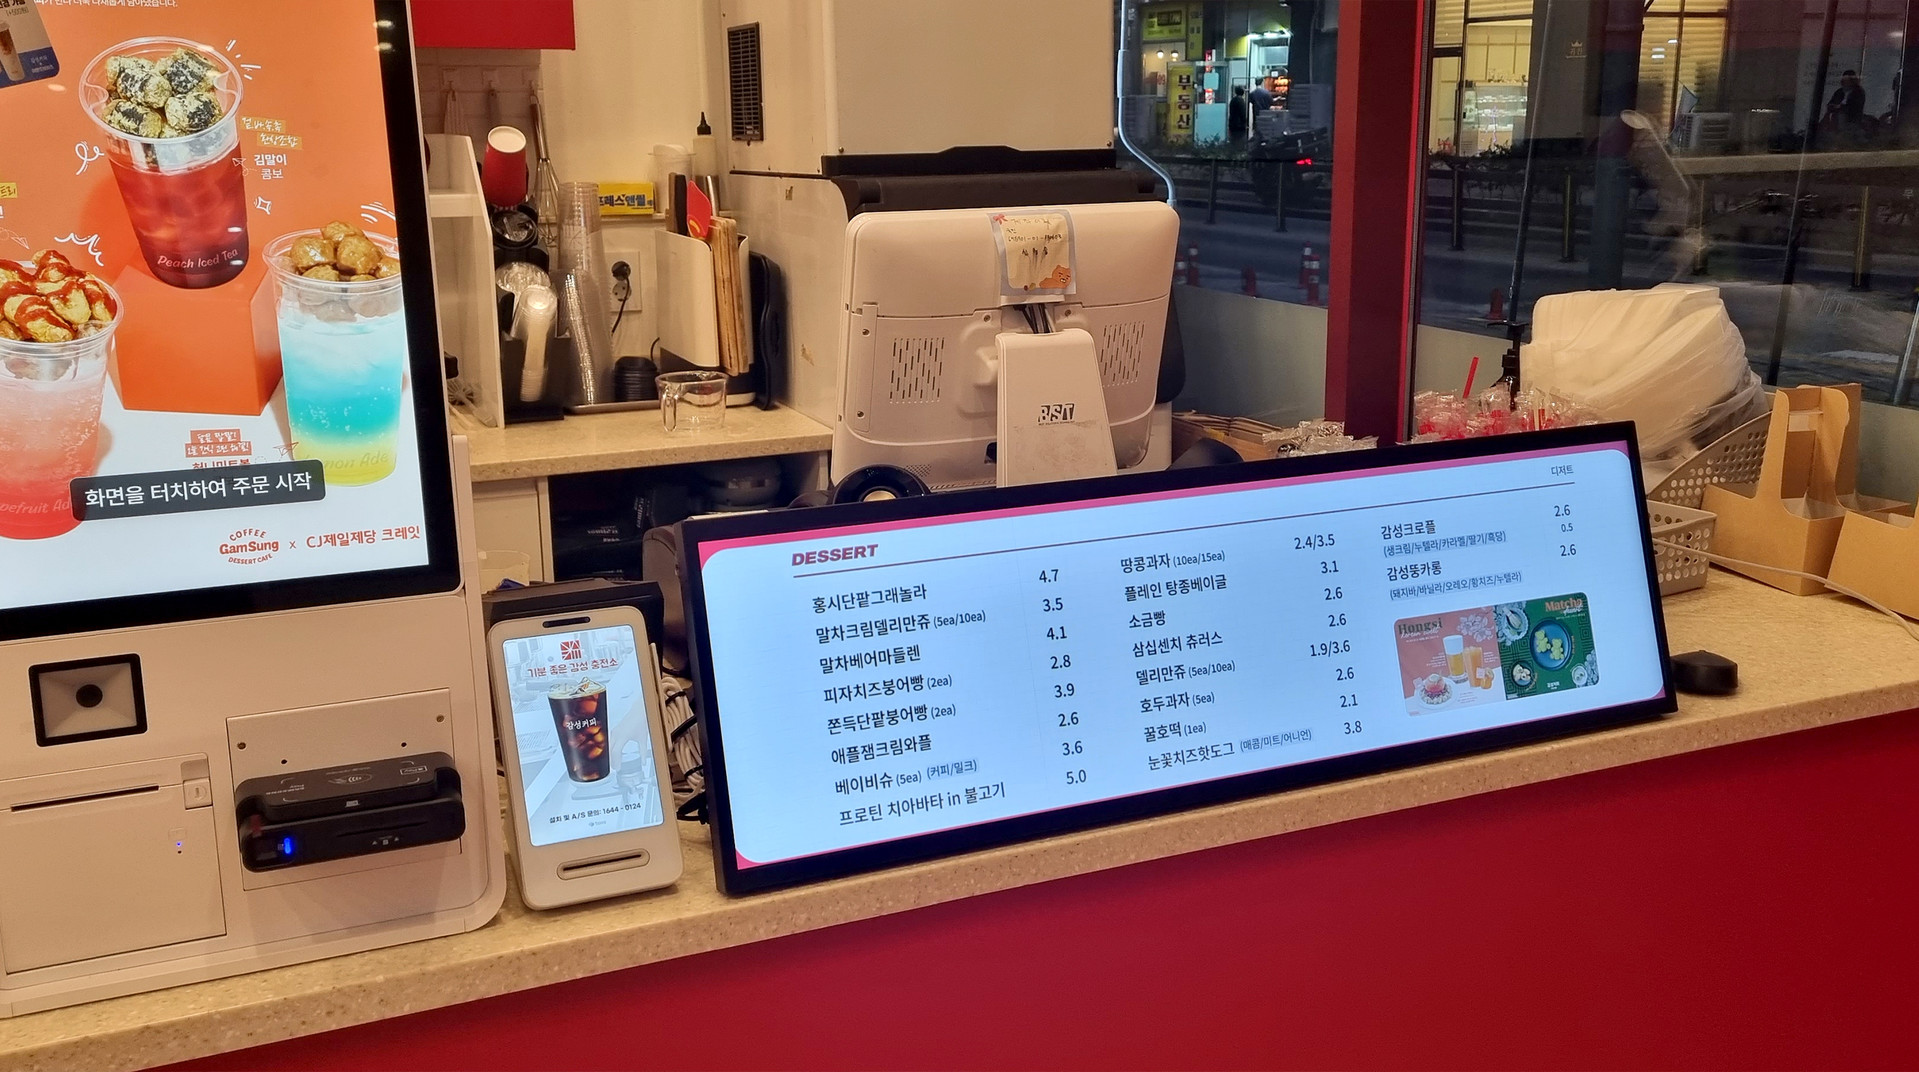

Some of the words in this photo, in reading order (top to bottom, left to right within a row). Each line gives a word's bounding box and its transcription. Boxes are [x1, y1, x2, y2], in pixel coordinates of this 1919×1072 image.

[1177, 74, 1191, 130] 부동산
[254, 154, 287, 166] 김말이
[261, 168, 284, 180] 콤보
[157, 255, 194, 268] Peach
[197, 254, 220, 268] Iced
[221, 248, 239, 261] Tea
[1037, 402, 1075, 423] BST
[1551, 464, 1574, 477] 디저트
[85, 485, 145, 508] 화면을
[150, 478, 227, 503] 터치하여
[232, 474, 271, 496] 주문
[275, 471, 313, 492] 시작
[1554, 504, 1571, 518] 2.6
[229, 528, 267, 542] COFFEE
[1381, 519, 1436, 540] 감성크로플
[1561, 522, 1574, 533] 0.5
[219, 540, 280, 555] GamSung
[306, 529, 377, 548] CJ제일제당
[381, 525, 420, 541] 크레잇
[1294, 533, 1335, 551] 2.4/3.5
[228, 556, 257, 565] DESSERT
[257, 553, 273, 564] CAFE
[791, 543, 879, 567] DESSERT
[1560, 543, 1577, 557] 2.6
[1120, 553, 1171, 574] 땅콩과자
[1172, 550, 1225, 568] (10ea/15ea)
[1320, 560, 1339, 574] 3.1
[1387, 560, 1442, 582] 감성뚱카롱
[1039, 569, 1059, 583] 4.7
[1124, 582, 1162, 602] 플레인
[1166, 573, 1227, 596] 탕종베이글
[1324, 586, 1343, 601] 2.6
[812, 583, 928, 614] 홍시단팥그래놀라
[1042, 597, 1063, 612] 3.5
[1545, 597, 1583, 611] Matcha
[816, 613, 930, 644] 말차크림델리만쥬
[933, 610, 986, 629] (5ea/10ea)
[1128, 610, 1166, 629] 소금빵
[1328, 613, 1347, 627] 2.6
[1398, 617, 1442, 635] Hongsi
[1046, 626, 1068, 640] 4.1
[1132, 636, 1182, 658] 삼십센치
[1186, 631, 1224, 650] 츄러스
[1310, 639, 1351, 657] 1.9/3.6
[527, 666, 547, 678] 기분
[549, 663, 568, 676] 좋은
[570, 660, 589, 672] 감성
[591, 658, 618, 671] 충전소
[819, 644, 922, 675] 말차베어마들렌
[1050, 654, 1071, 669] 2.8
[1136, 664, 1187, 686] 델리만쥬
[1188, 660, 1236, 679] (5ea/10ea)
[1335, 667, 1355, 681] 2.6
[824, 674, 924, 704] 피자치즈붕어빵
[927, 674, 952, 690] (2ea)
[1054, 683, 1075, 698] 3.9
[1140, 692, 1190, 713] 호두과자
[1192, 692, 1215, 707] (5ea)
[1340, 694, 1358, 708] 2.1
[566, 717, 597, 731] 감성커피
[827, 704, 928, 735] 쫀득단팥붕어빵
[930, 704, 956, 719] (2ea)
[1058, 711, 1079, 727] 2.6
[1344, 720, 1362, 735] 3.8
[1144, 722, 1182, 743] 꿀호떡
[1183, 722, 1207, 737] (1ea)
[831, 734, 932, 765] 애플잼크림와플
[1062, 740, 1083, 756] 3.6
[1148, 742, 1235, 771] 눈꽃치즈핫도그
[835, 772, 893, 795] 베이비슈
[896, 771, 922, 786] (5ea)
[927, 759, 977, 780] (커피/밀크)
[1066, 769, 1087, 785] 5.0
[571, 811, 586, 820] A/S
[603, 806, 619, 815] 1644
[625, 802, 641, 811] 0124
[839, 804, 883, 826] 프로틴
[888, 793, 944, 817] 치아바타
[947, 792, 961, 806] in
[964, 782, 1006, 805] 불고기
